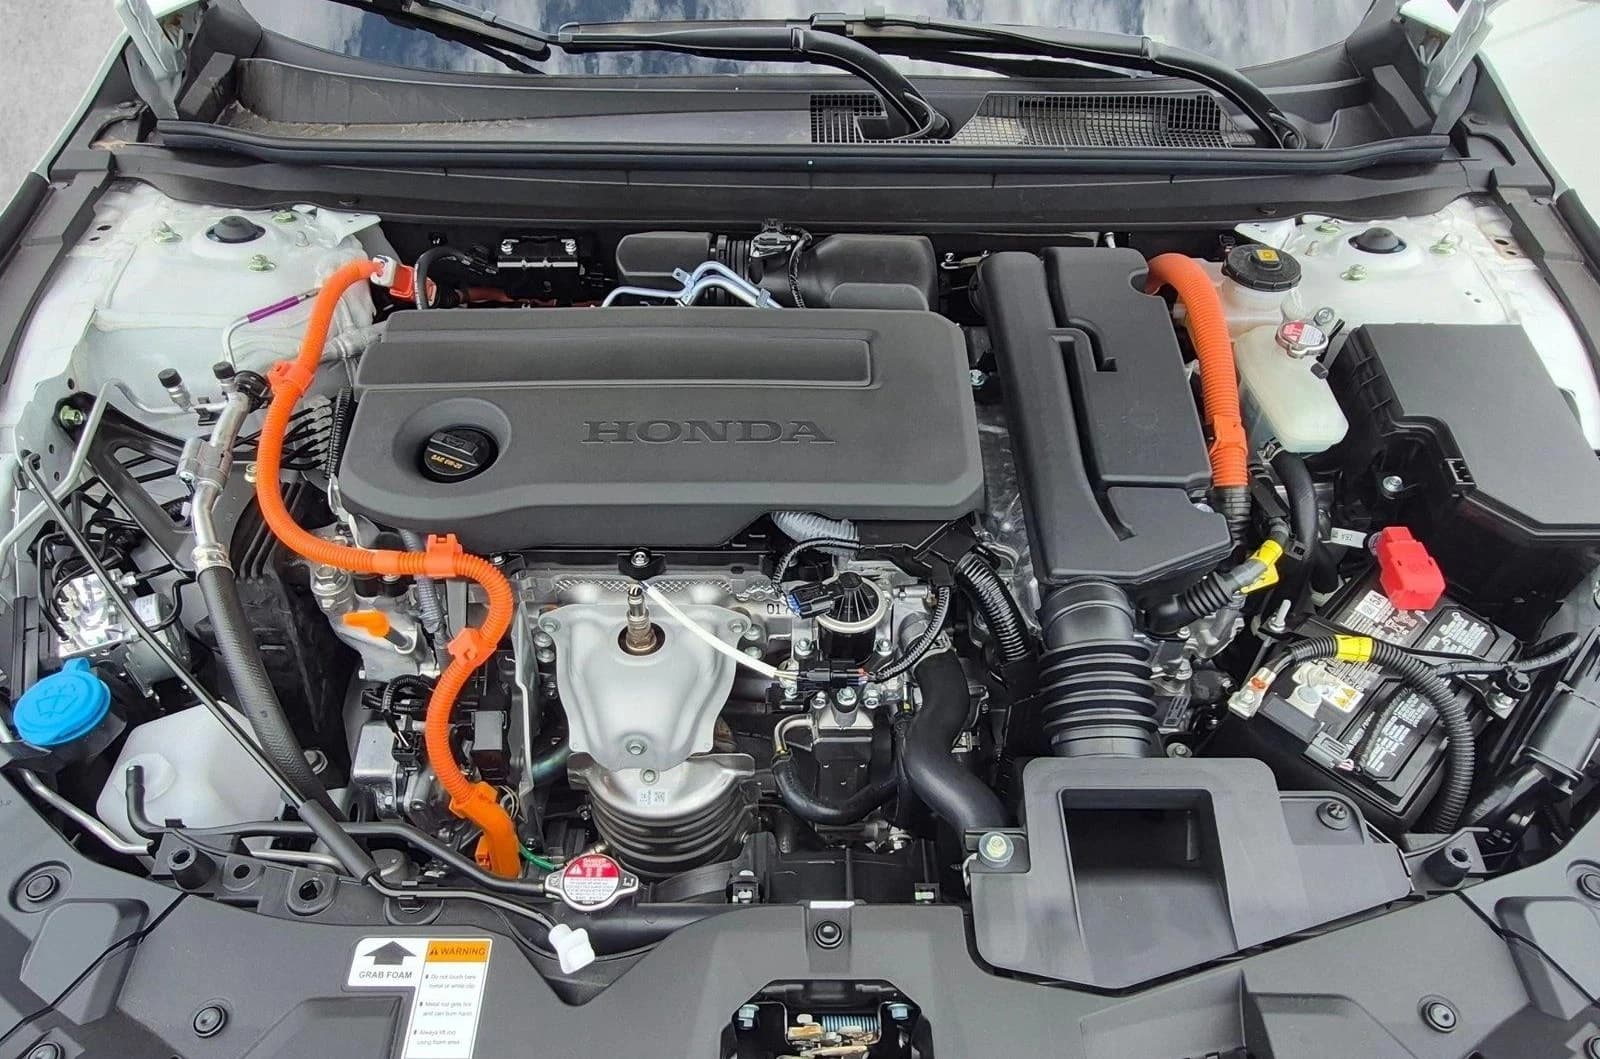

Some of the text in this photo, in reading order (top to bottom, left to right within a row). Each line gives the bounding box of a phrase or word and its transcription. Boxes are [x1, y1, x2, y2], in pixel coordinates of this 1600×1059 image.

[580, 420, 836, 444] HONDA
[441, 947, 486, 956] WARNING
[358, 971, 413, 979] GRAB FOAM
